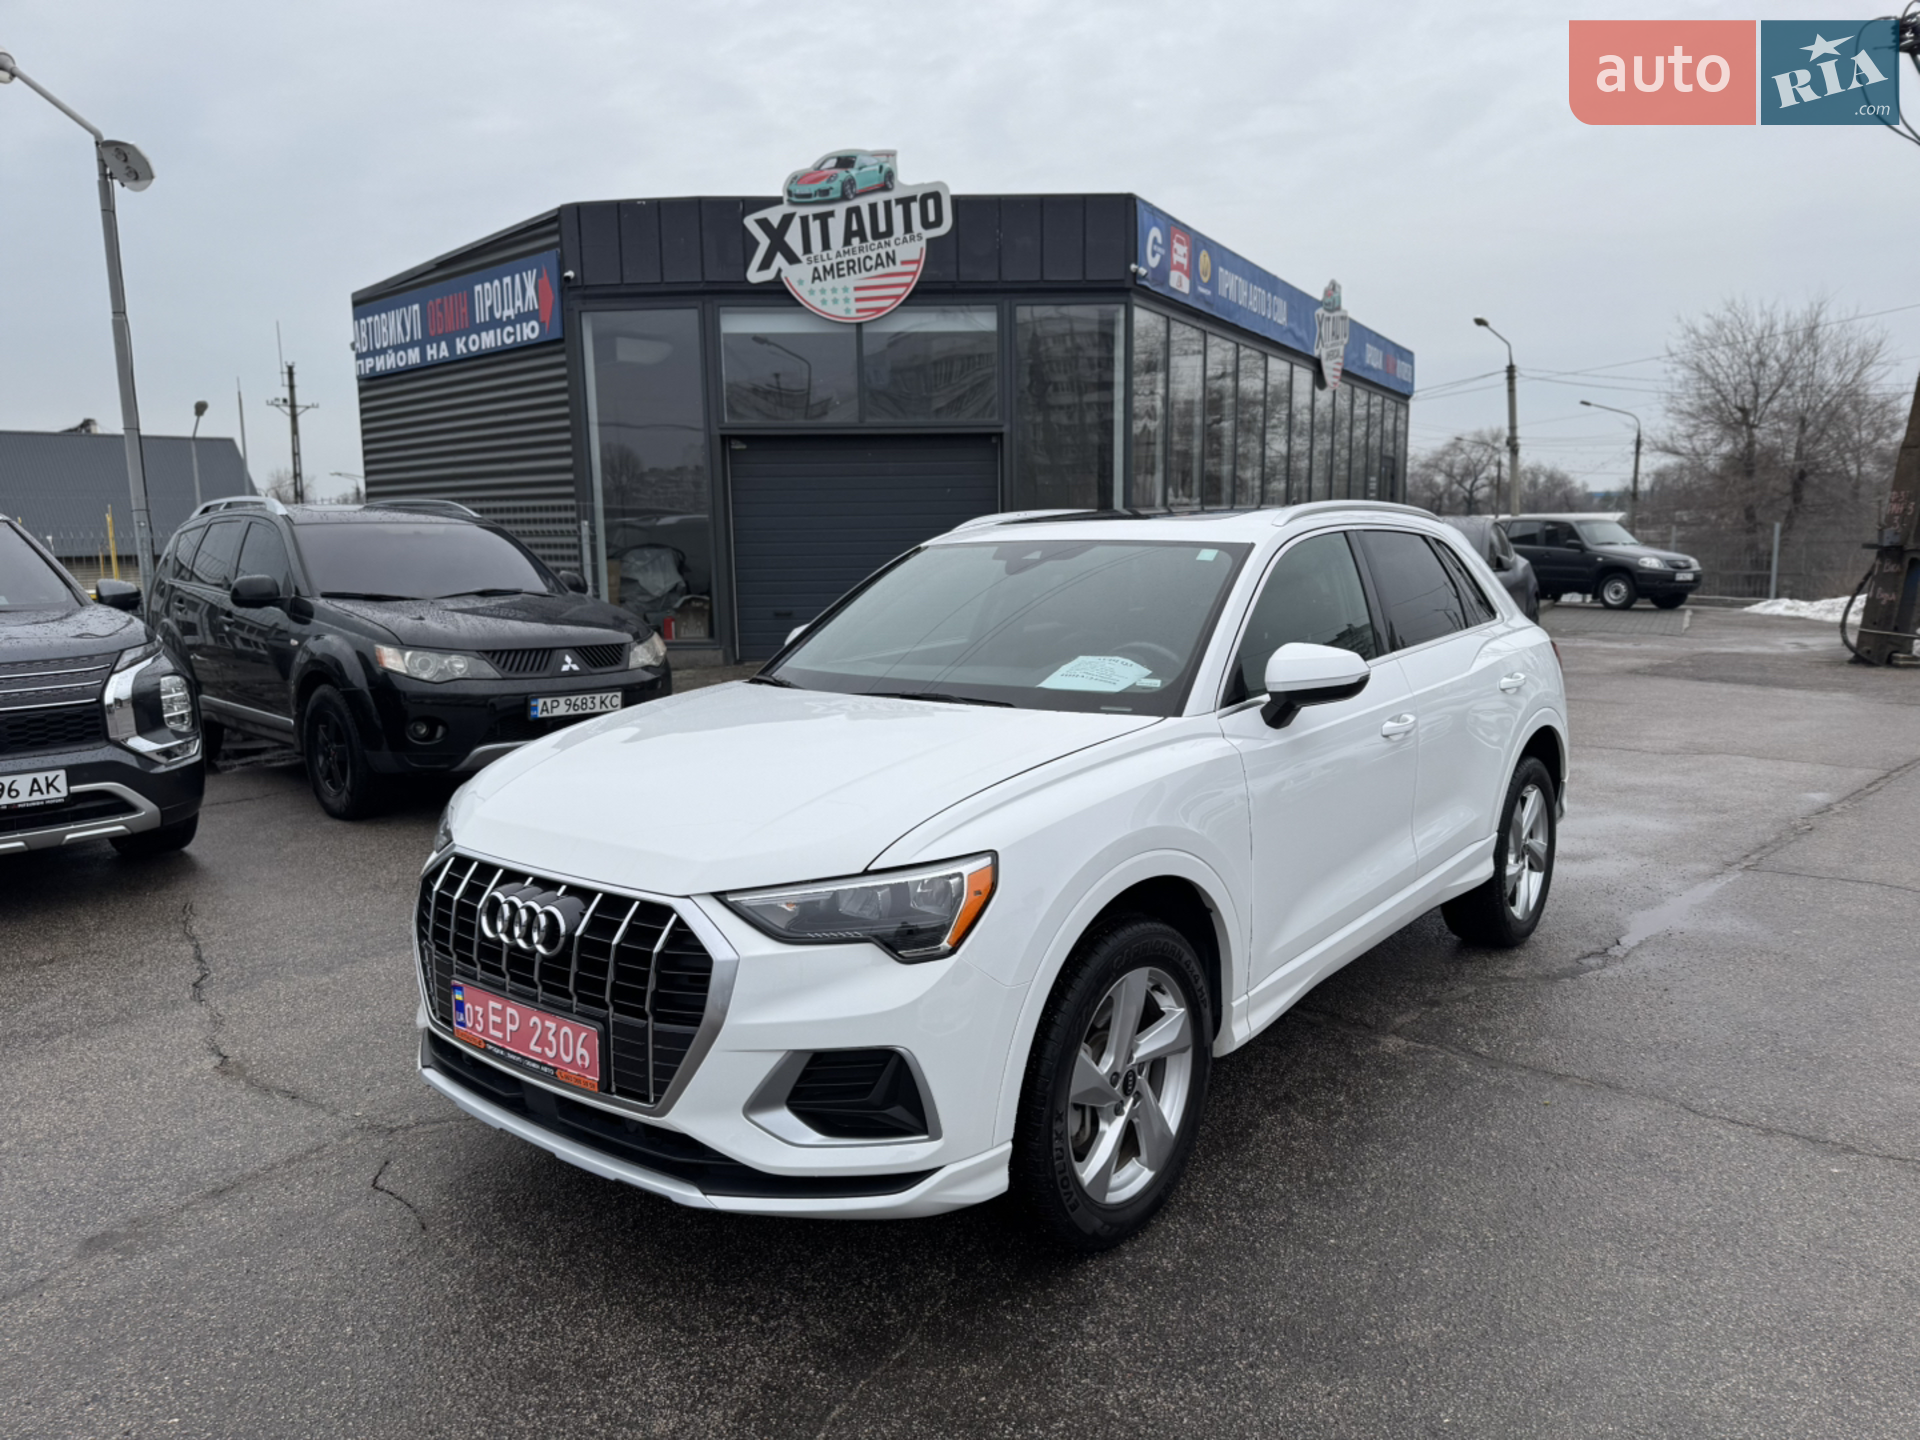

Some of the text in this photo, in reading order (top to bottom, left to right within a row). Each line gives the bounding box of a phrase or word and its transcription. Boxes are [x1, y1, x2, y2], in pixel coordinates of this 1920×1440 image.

[806, 232, 924, 266] SELL AMERICAN CARS
[811, 249, 897, 285] AMERICAN
[354, 268, 539, 354] АВТОВИКУП ОБМІН ПРОДАЖ
[1248, 283, 1267, 317] АВТО
[1272, 295, 1288, 327] США
[356, 320, 540, 376] ПРИЙОМ НА КОМІСІЮ
[540, 694, 619, 715] AP 9683 KC
[28, 774, 61, 797] AK
[1112, 939, 1185, 969] CAPRICORN
[465, 1003, 484, 1032] 03
[488, 1000, 520, 1042] EP
[529, 1016, 590, 1069] 2306
